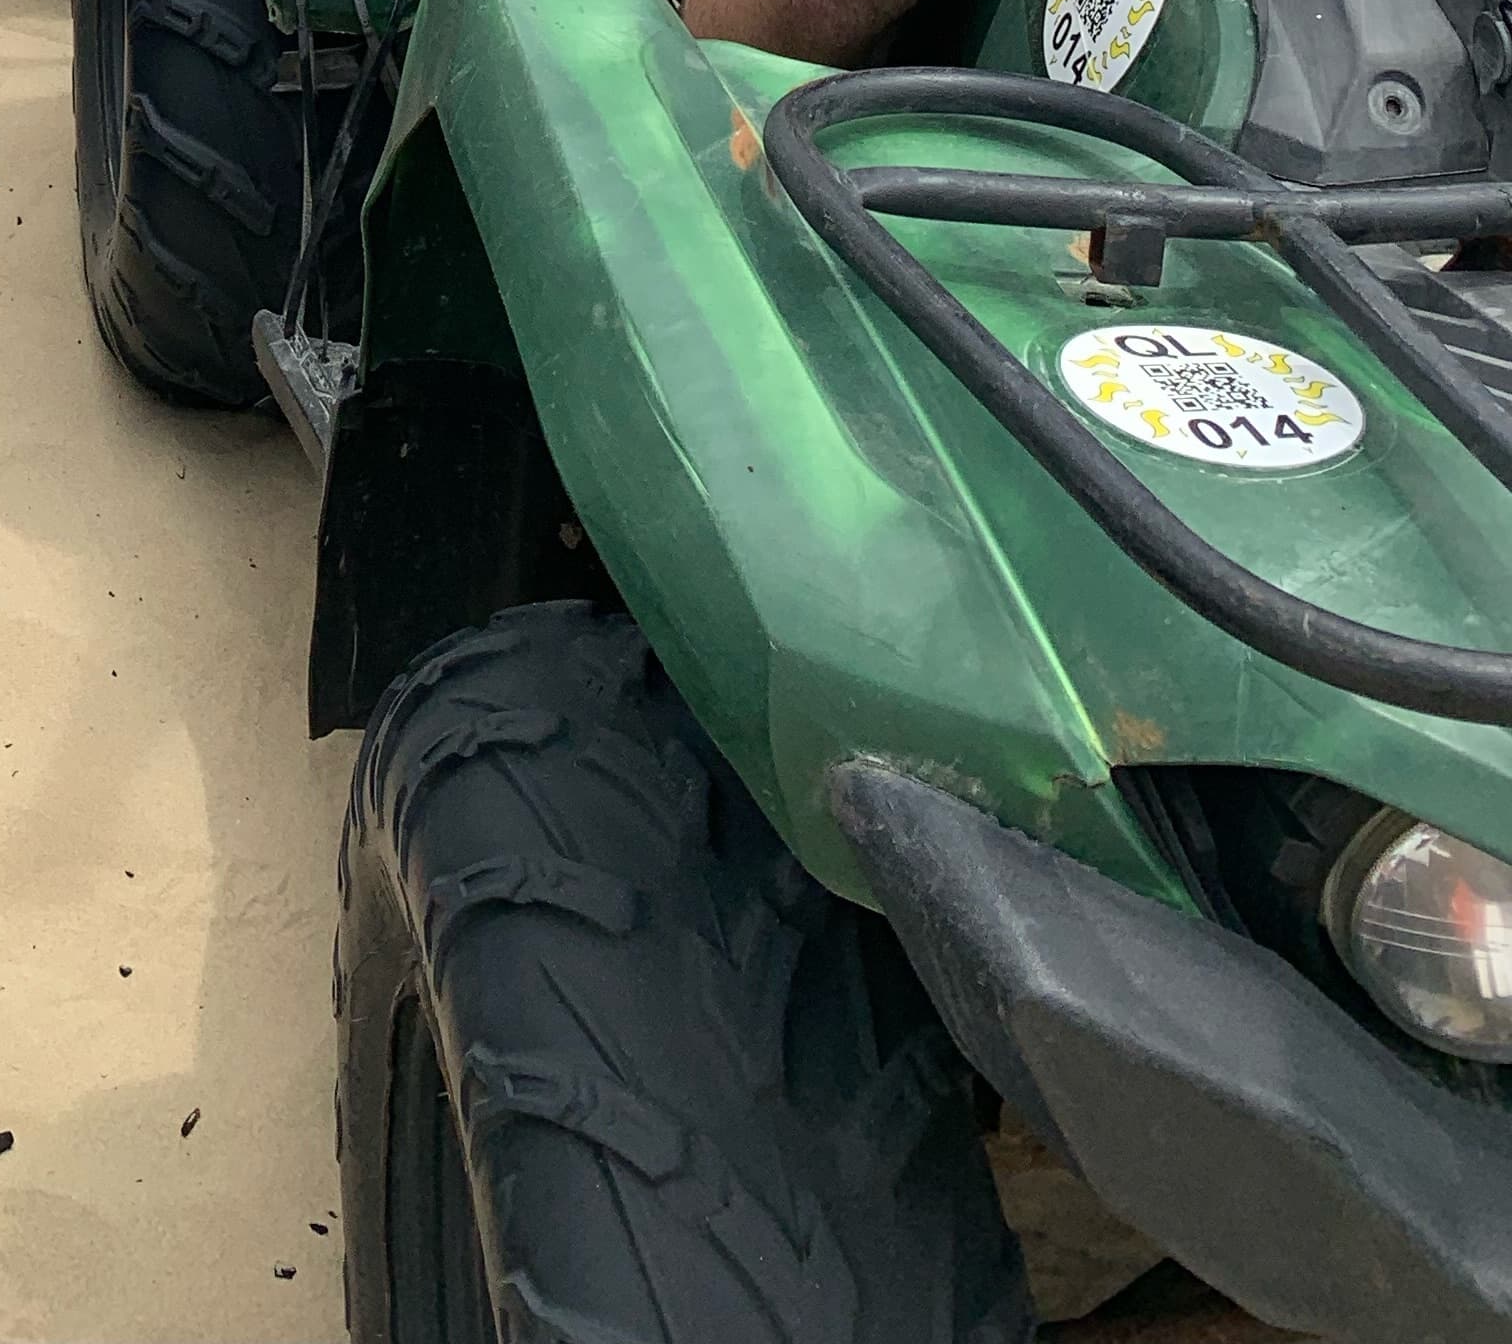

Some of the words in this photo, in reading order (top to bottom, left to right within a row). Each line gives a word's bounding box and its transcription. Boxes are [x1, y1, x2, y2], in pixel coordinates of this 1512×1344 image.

[1051, 11, 1088, 87] 014
[1114, 333, 1217, 361] QL
[1188, 413, 1314, 451] 014
